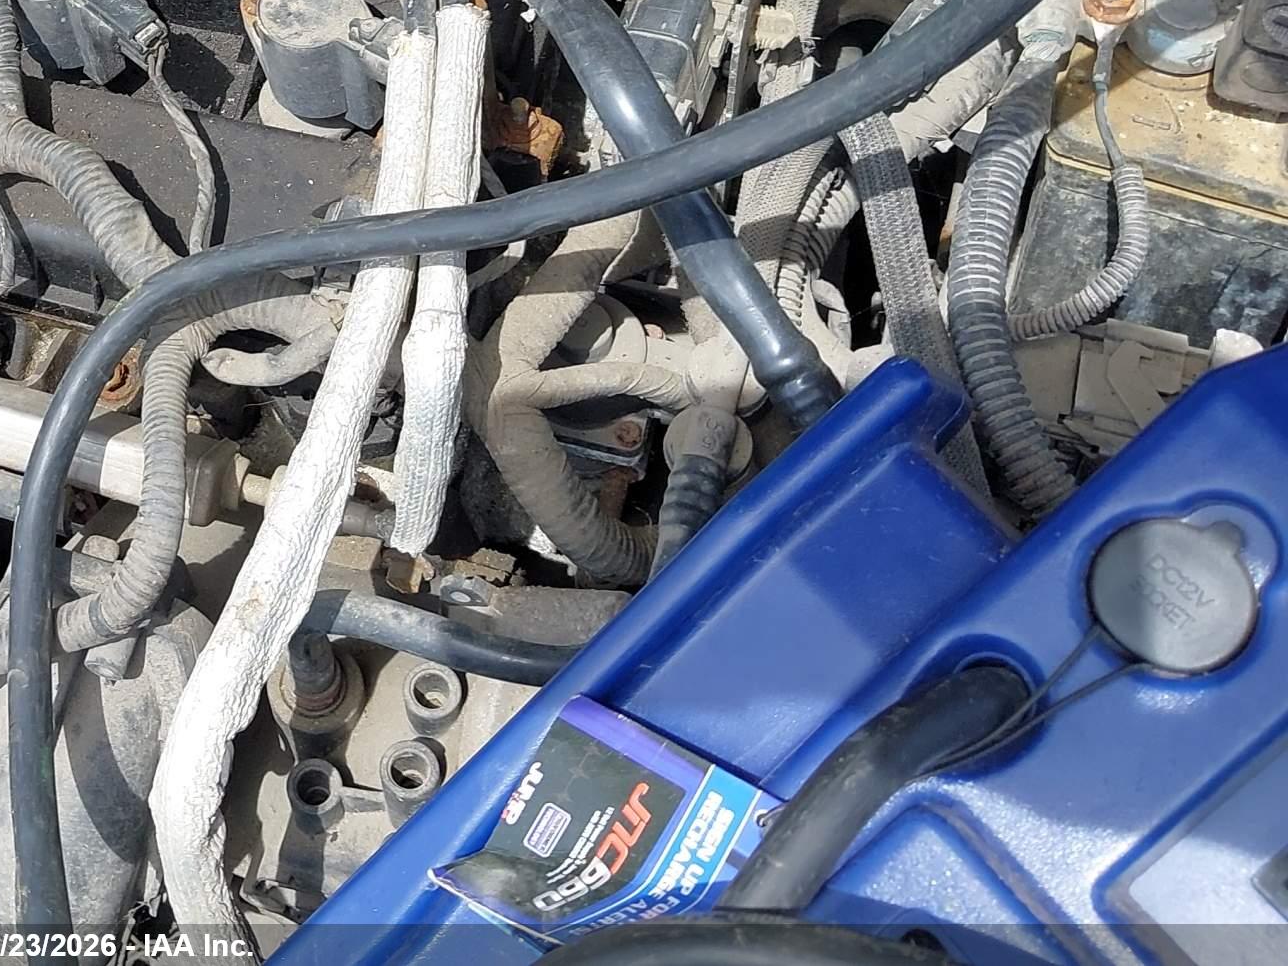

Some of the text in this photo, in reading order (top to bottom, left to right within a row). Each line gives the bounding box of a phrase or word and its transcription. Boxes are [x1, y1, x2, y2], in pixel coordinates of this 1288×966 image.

[1145, 552, 1216, 609] DC12V
[648, 790, 724, 900] RECHARGE
[679, 863, 705, 896] UP
[638, 895, 681, 920] FOR
